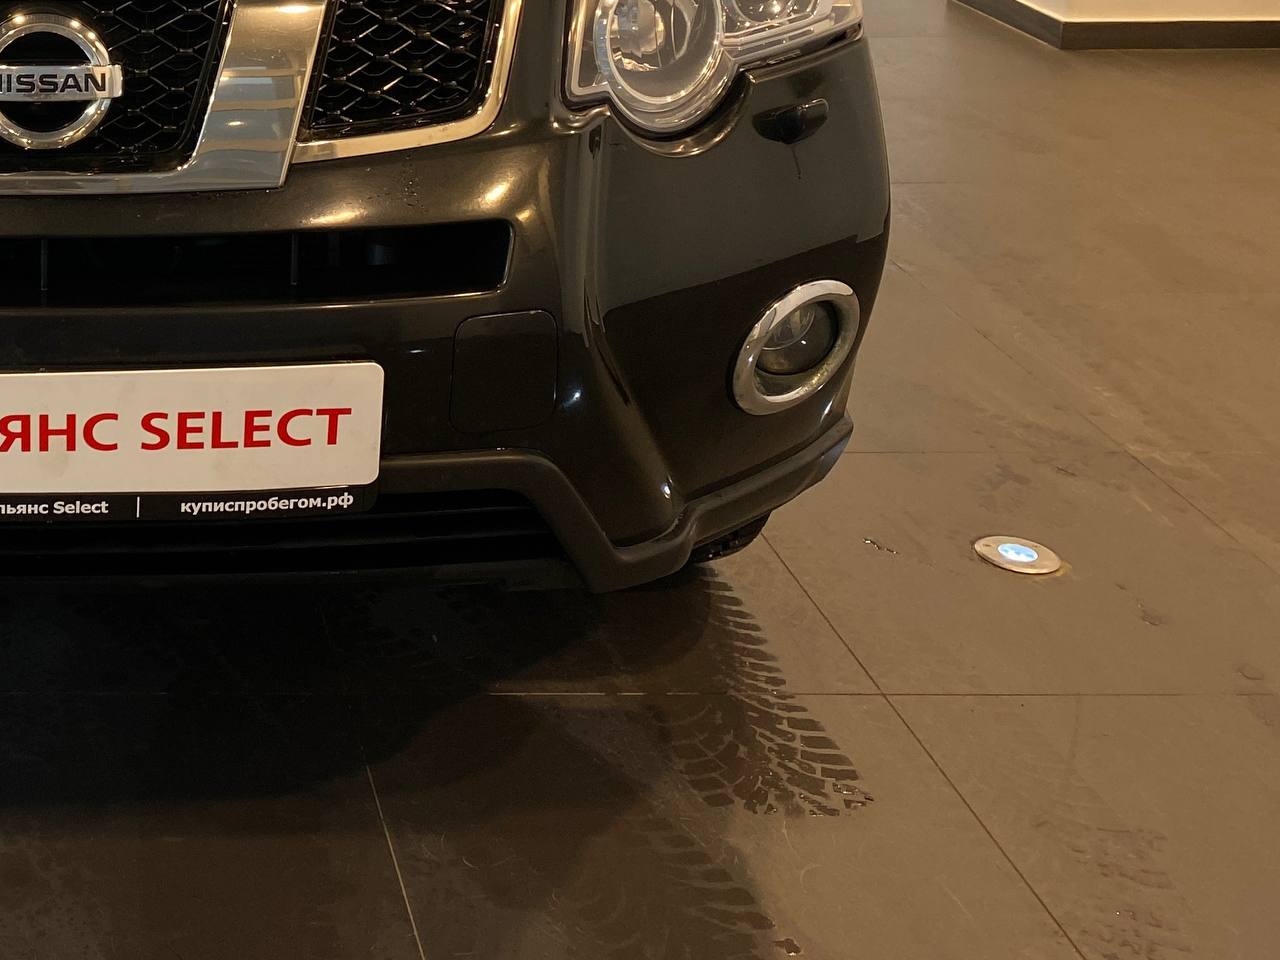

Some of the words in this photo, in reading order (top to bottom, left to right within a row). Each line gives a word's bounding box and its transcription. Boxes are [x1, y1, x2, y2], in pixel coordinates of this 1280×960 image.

[141, 408, 352, 451] SELECT
[52, 500, 109, 515] Select
[180, 492, 354, 516] куписпробегом.рф
